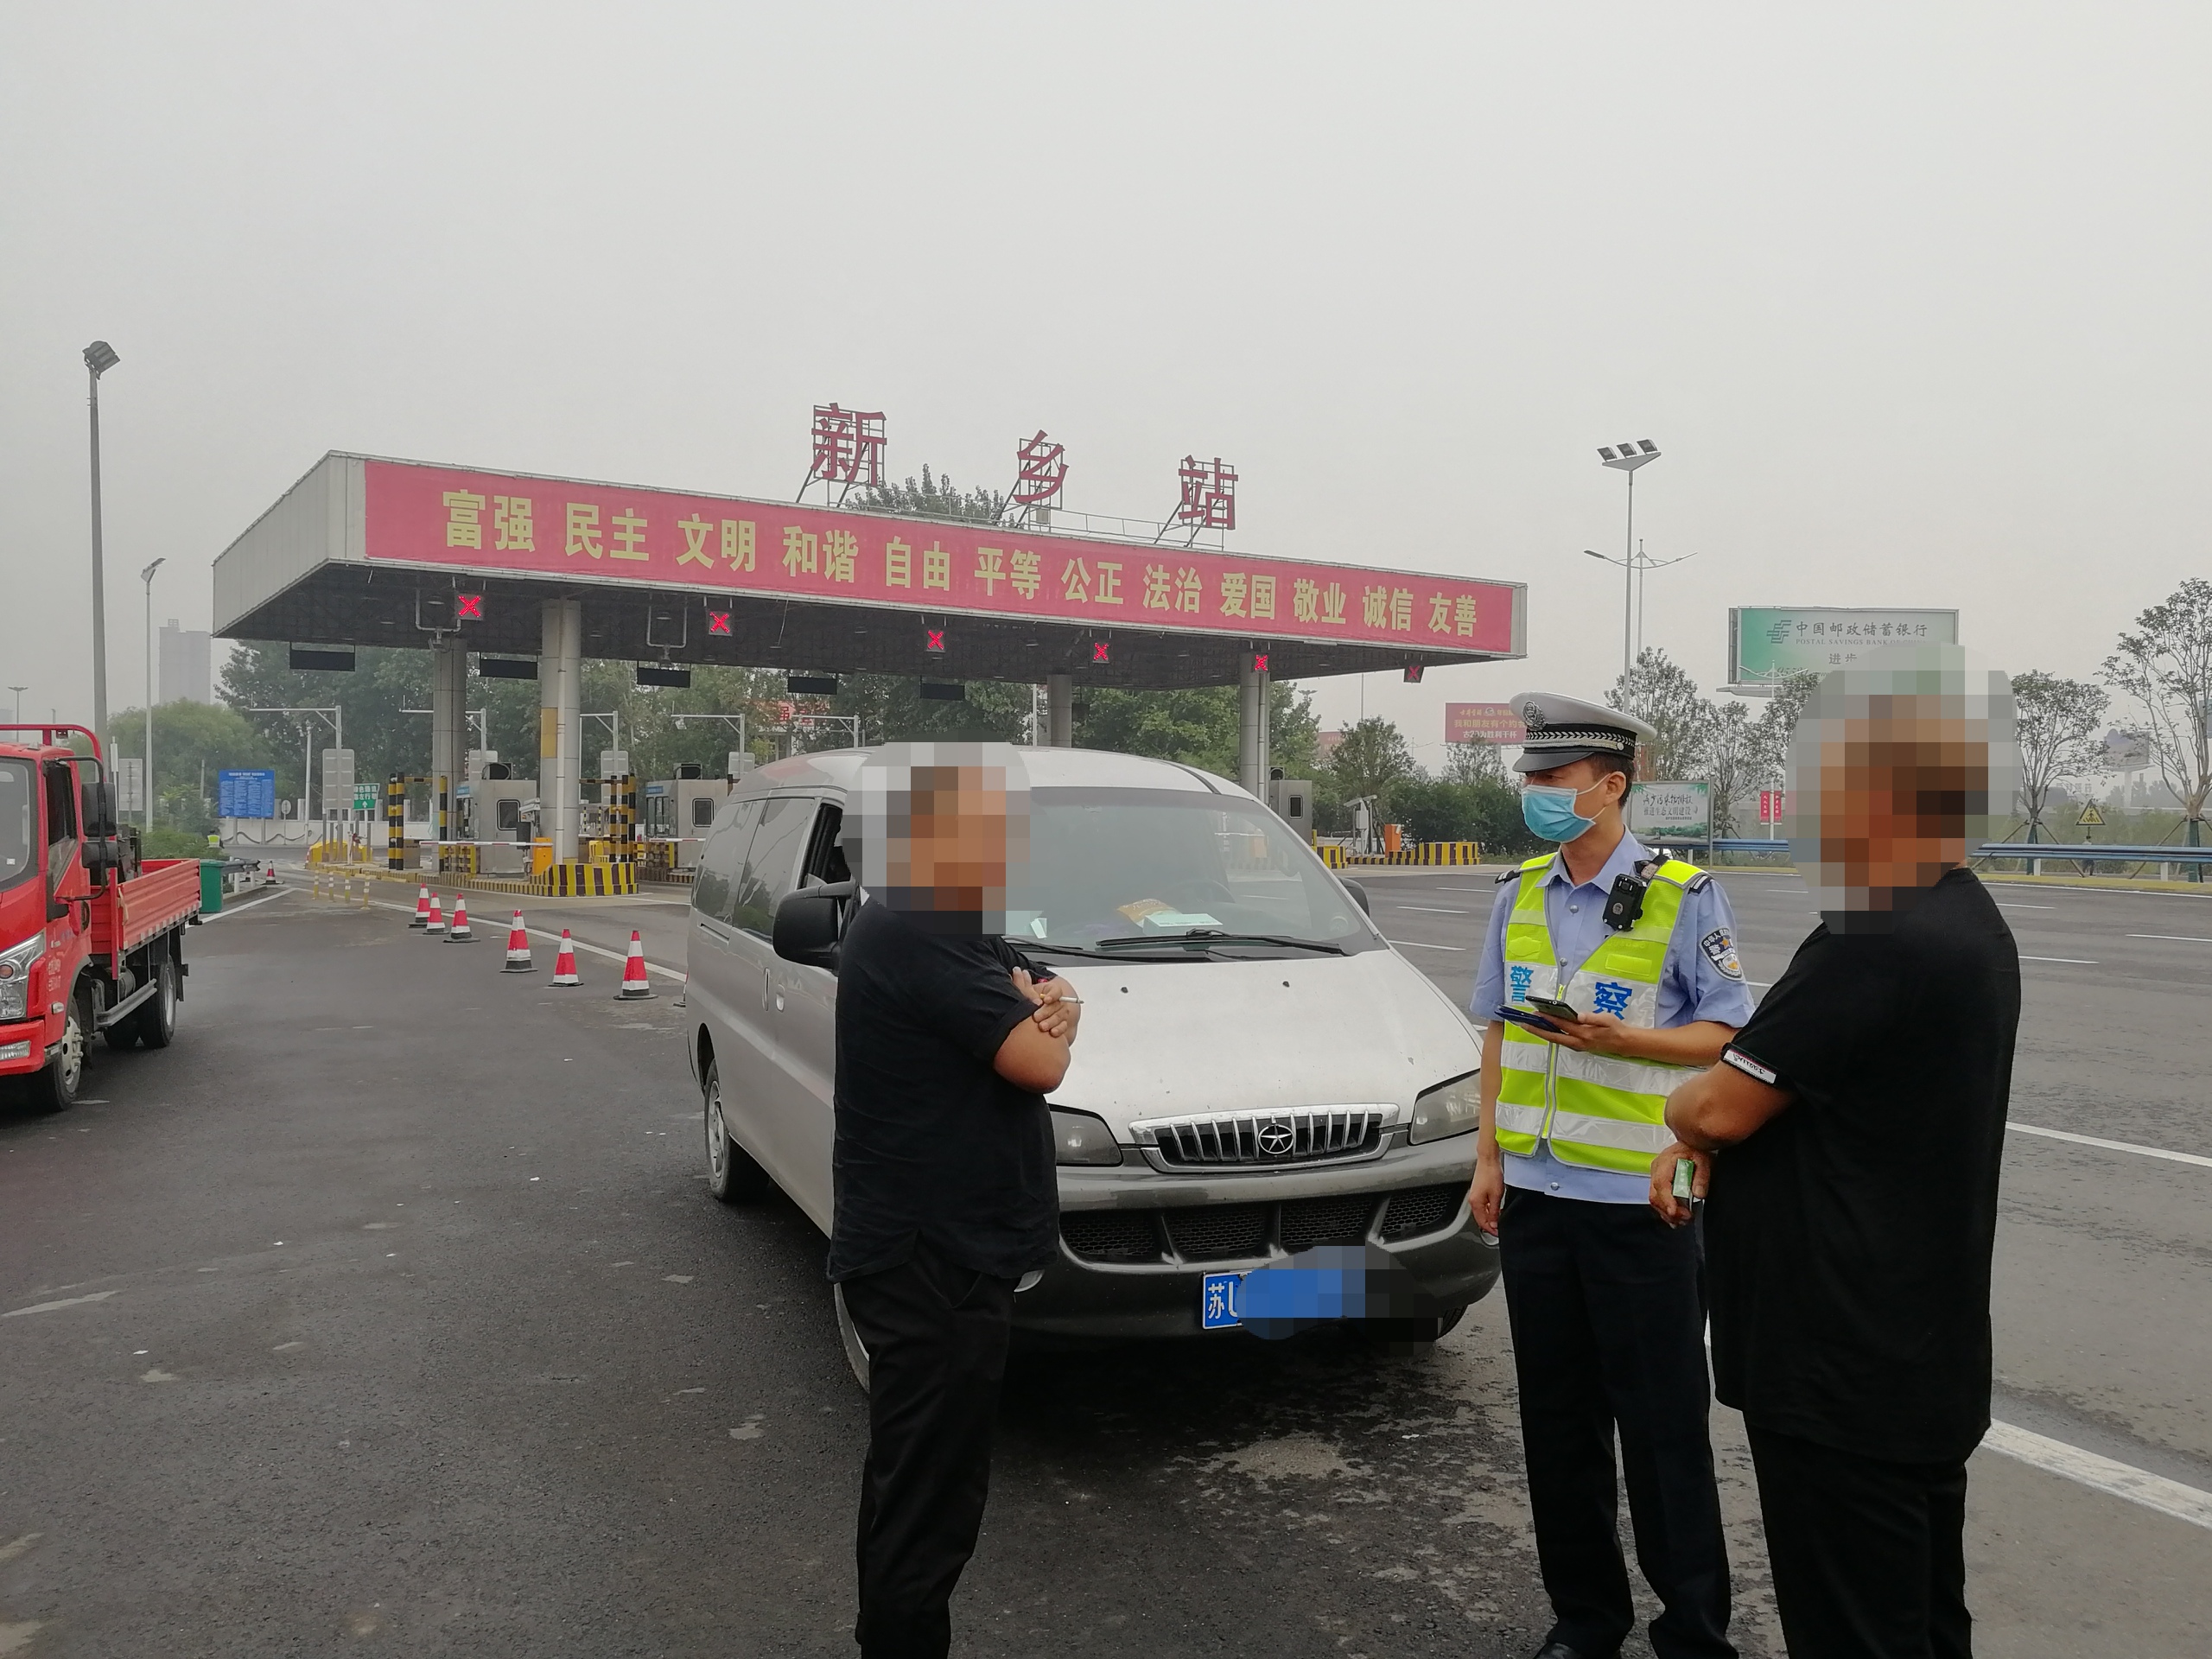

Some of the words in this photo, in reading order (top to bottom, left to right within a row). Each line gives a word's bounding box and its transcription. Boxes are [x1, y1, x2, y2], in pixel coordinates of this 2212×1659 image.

[442, 489, 536, 552] 富强
[564, 502, 649, 561] 民主
[676, 513, 756, 572] 文明
[782, 525, 858, 582] 和谐
[885, 537, 951, 591] 自由
[974, 547, 1041, 599] 平等
[1061, 556, 1123, 604] 公正
[1142, 564, 1202, 613] 法治
[1220, 572, 1275, 620] 爱国
[1293, 579, 1345, 625] 敬业
[1362, 585, 1414, 631] 诚信
[1428, 592, 1477, 637] 友善
[1796, 621, 1928, 638] 中国邮政储蓄银行
[1643, 806, 1691, 817] 推进生态文明建设
[1592, 982, 1633, 1020] 察
